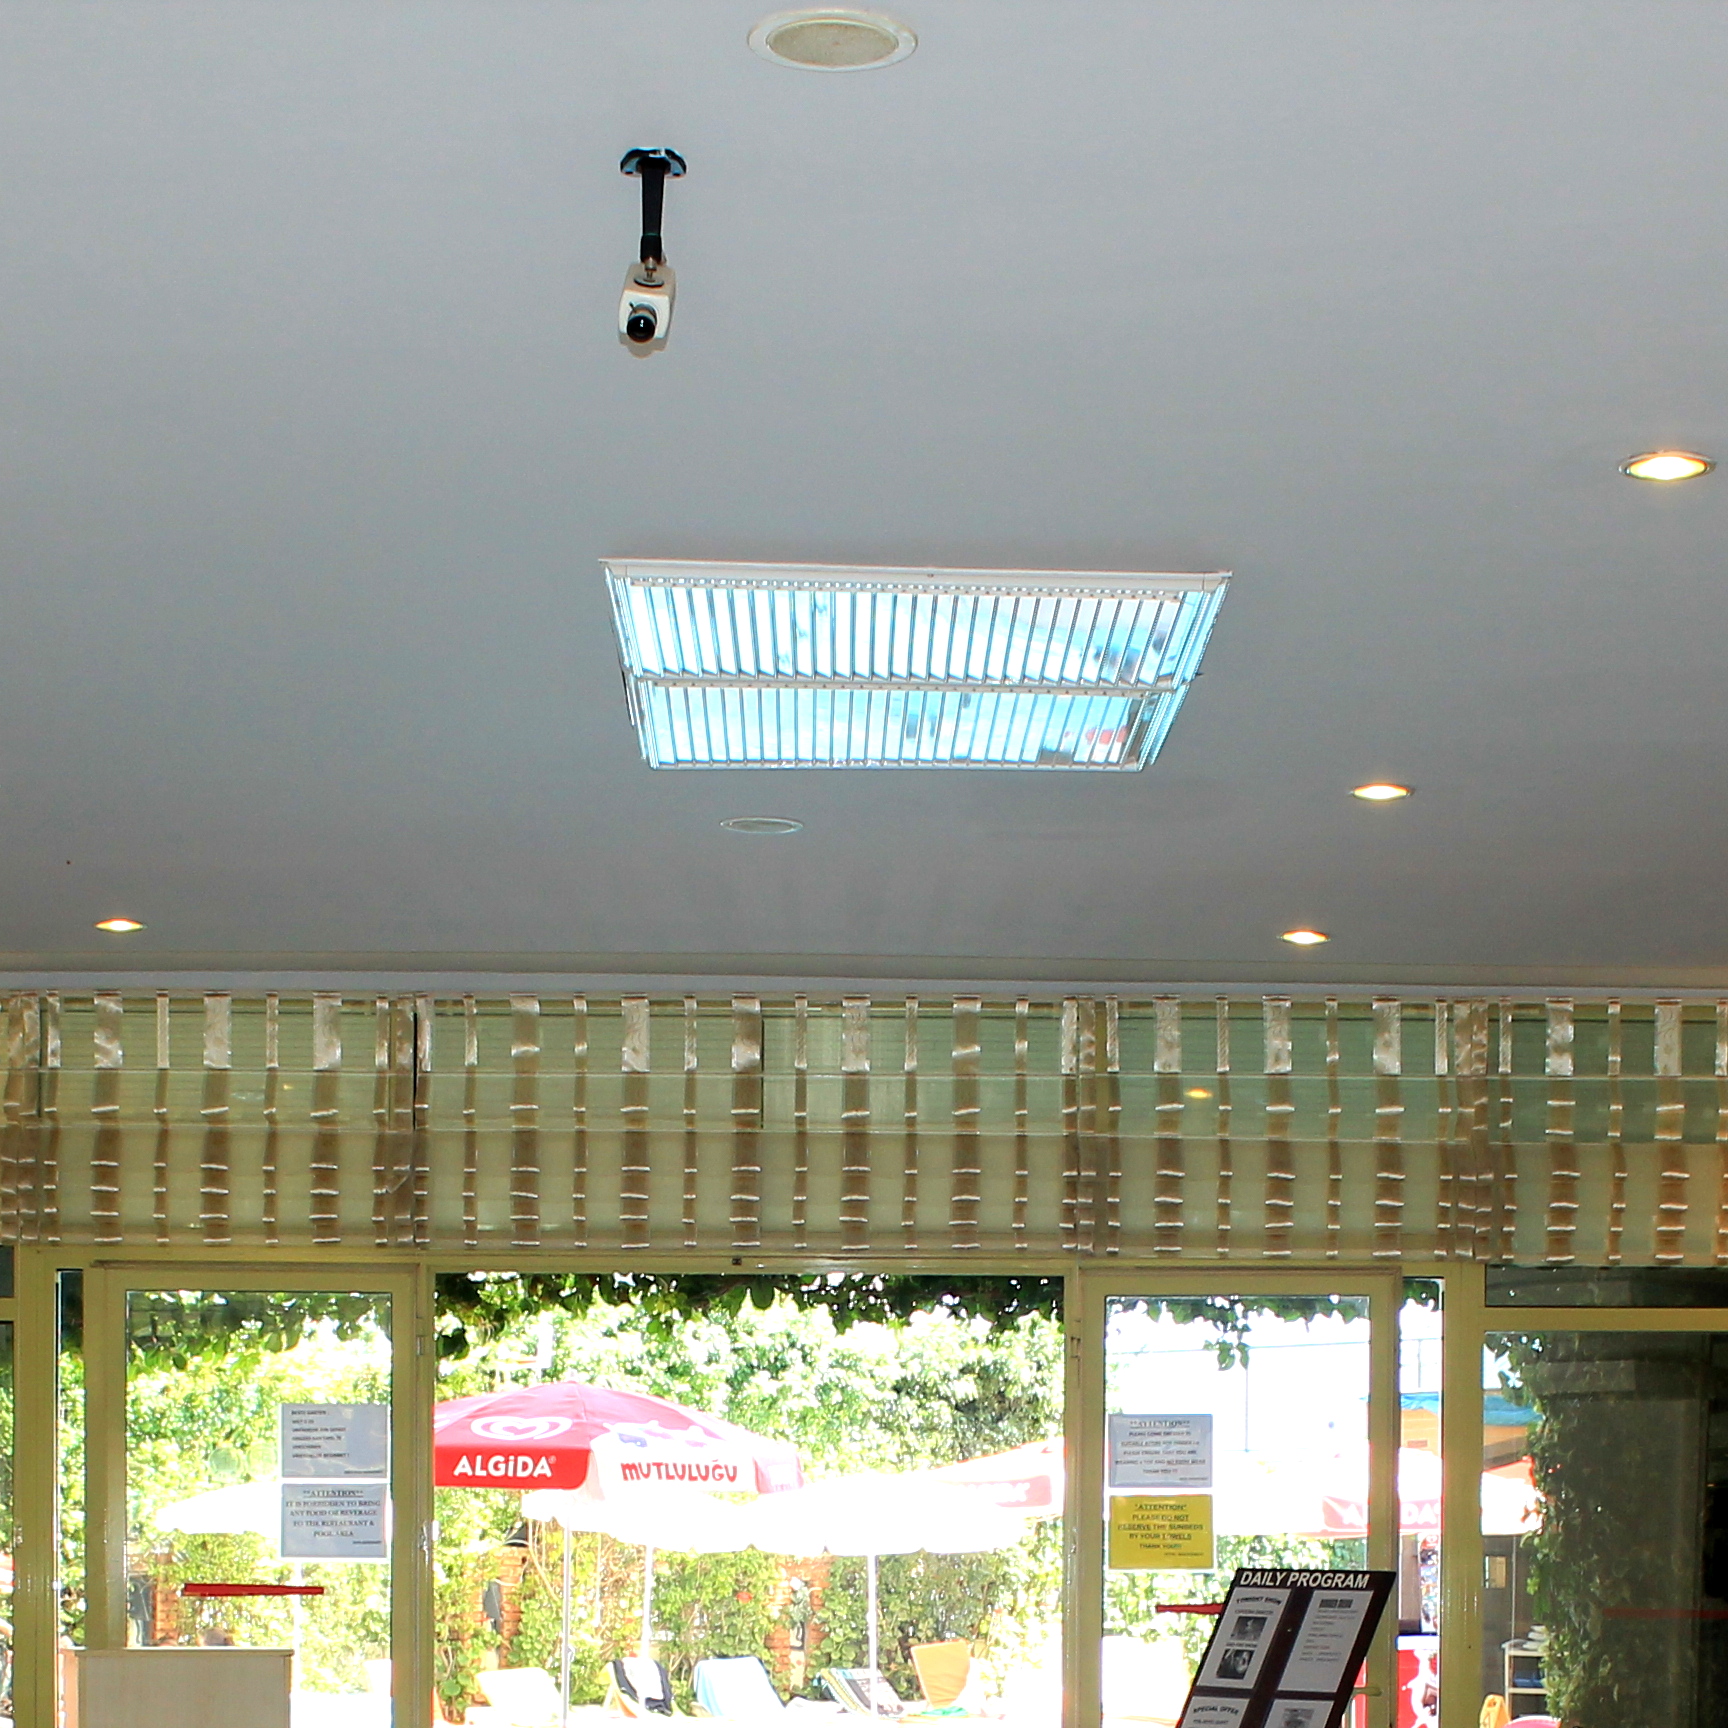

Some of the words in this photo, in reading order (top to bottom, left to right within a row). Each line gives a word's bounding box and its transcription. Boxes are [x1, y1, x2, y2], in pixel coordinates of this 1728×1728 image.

[1342, 1503, 1438, 1528] ADA
[1239, 1571, 1288, 1586] DAILY
[1286, 1572, 1371, 1589] PROGRAM
